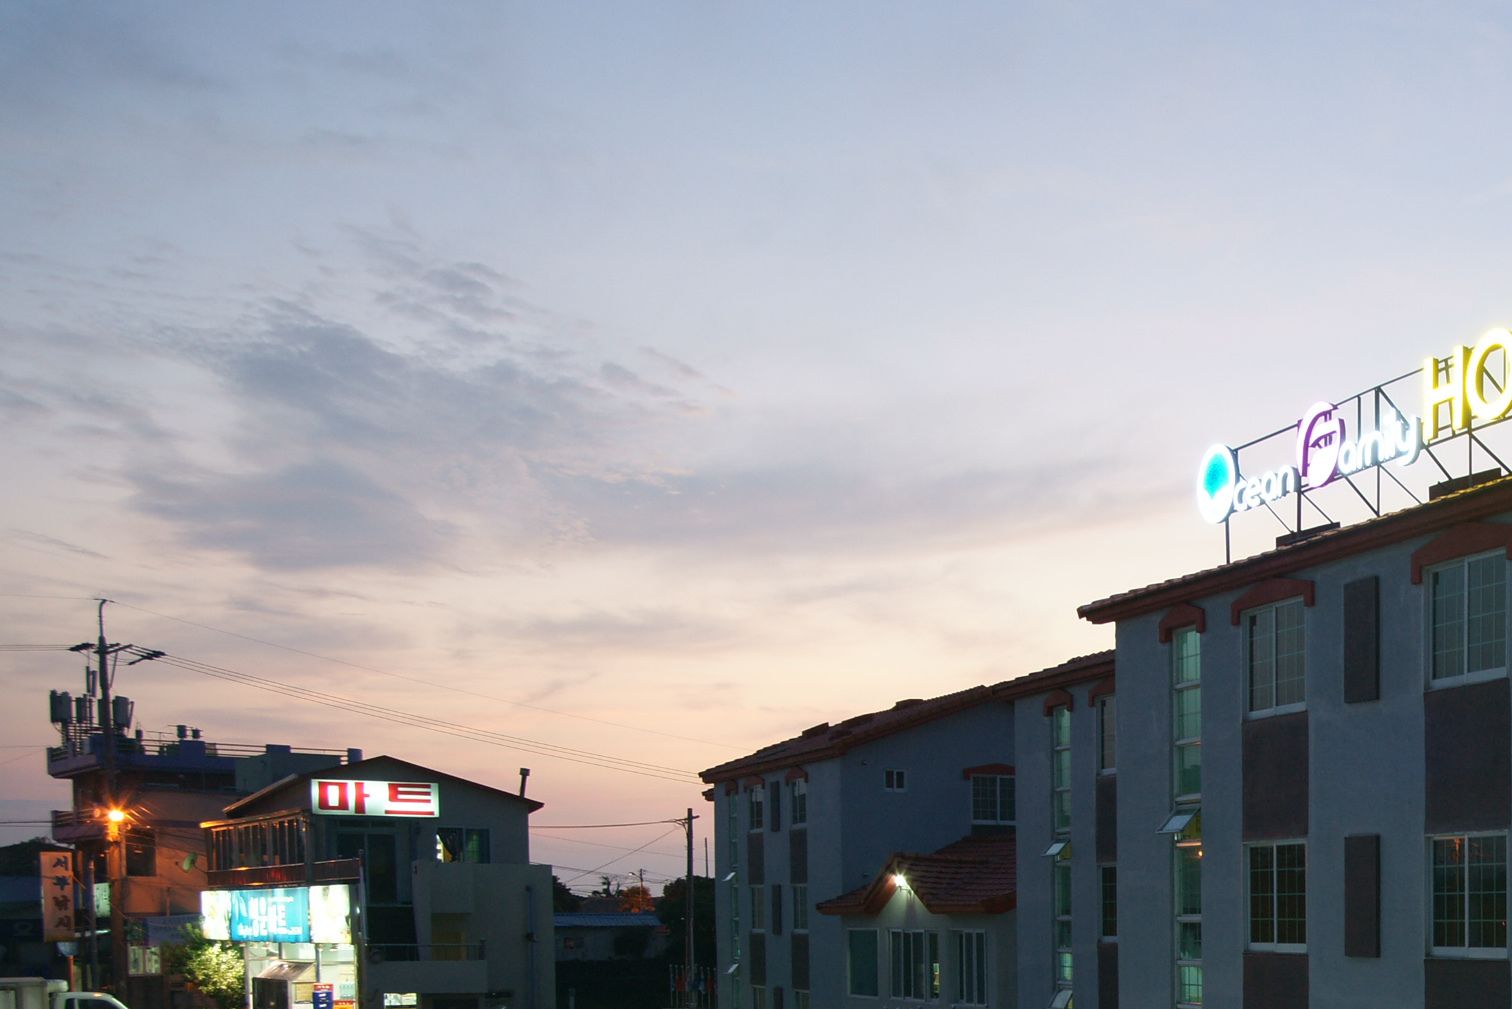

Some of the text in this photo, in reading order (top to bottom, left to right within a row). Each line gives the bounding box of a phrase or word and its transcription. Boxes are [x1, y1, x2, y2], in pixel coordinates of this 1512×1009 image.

[1197, 443, 1300, 524] Ocean
[1296, 401, 1421, 488] Family
[318, 781, 435, 816] 마트
